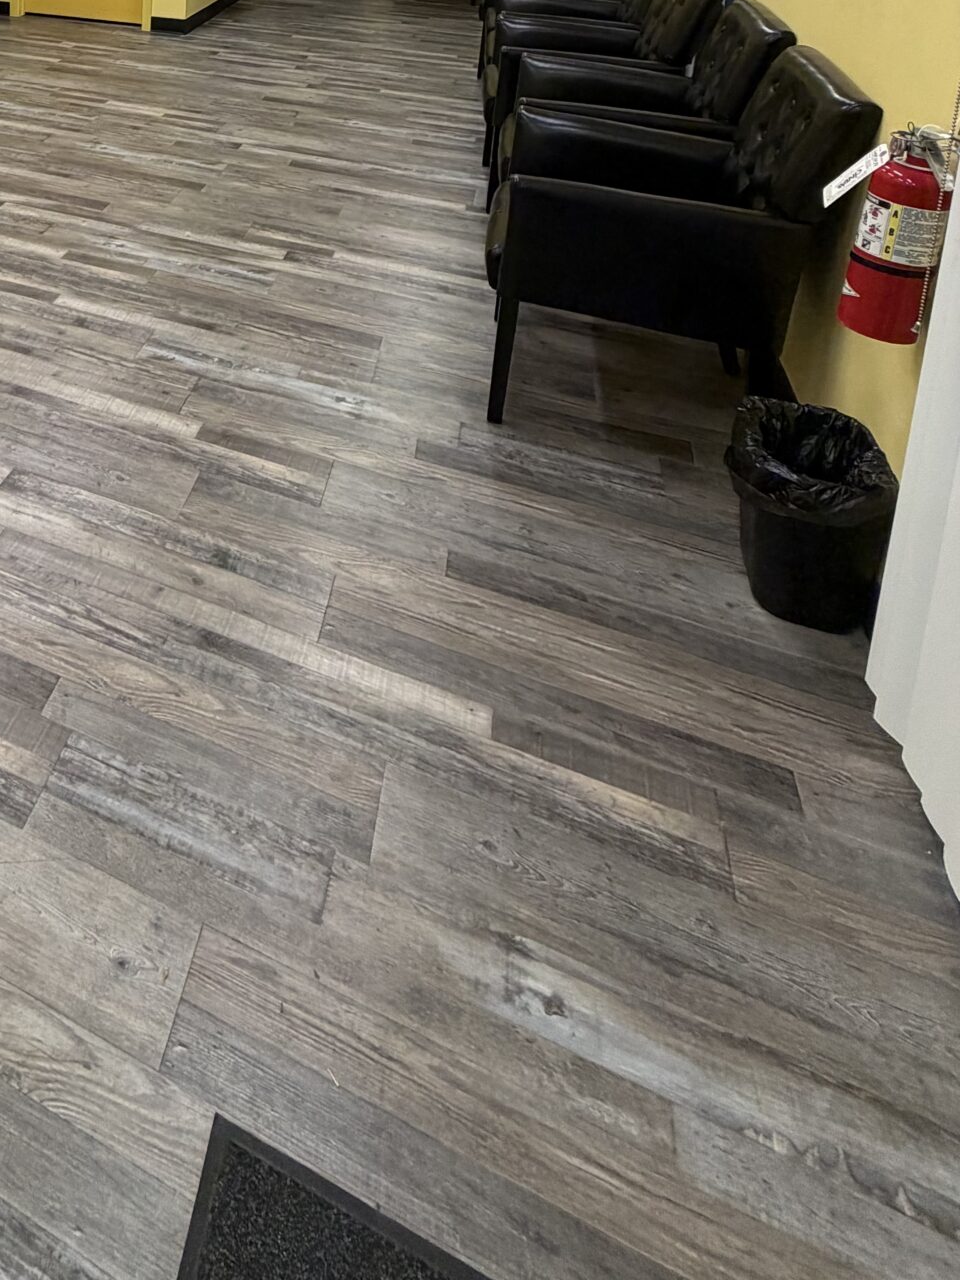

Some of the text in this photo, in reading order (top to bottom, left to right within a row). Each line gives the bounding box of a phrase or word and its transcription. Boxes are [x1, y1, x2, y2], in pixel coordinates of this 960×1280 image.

[892, 210, 898, 218] A
[889, 228, 894, 236] B
[885, 246, 890, 254] C
